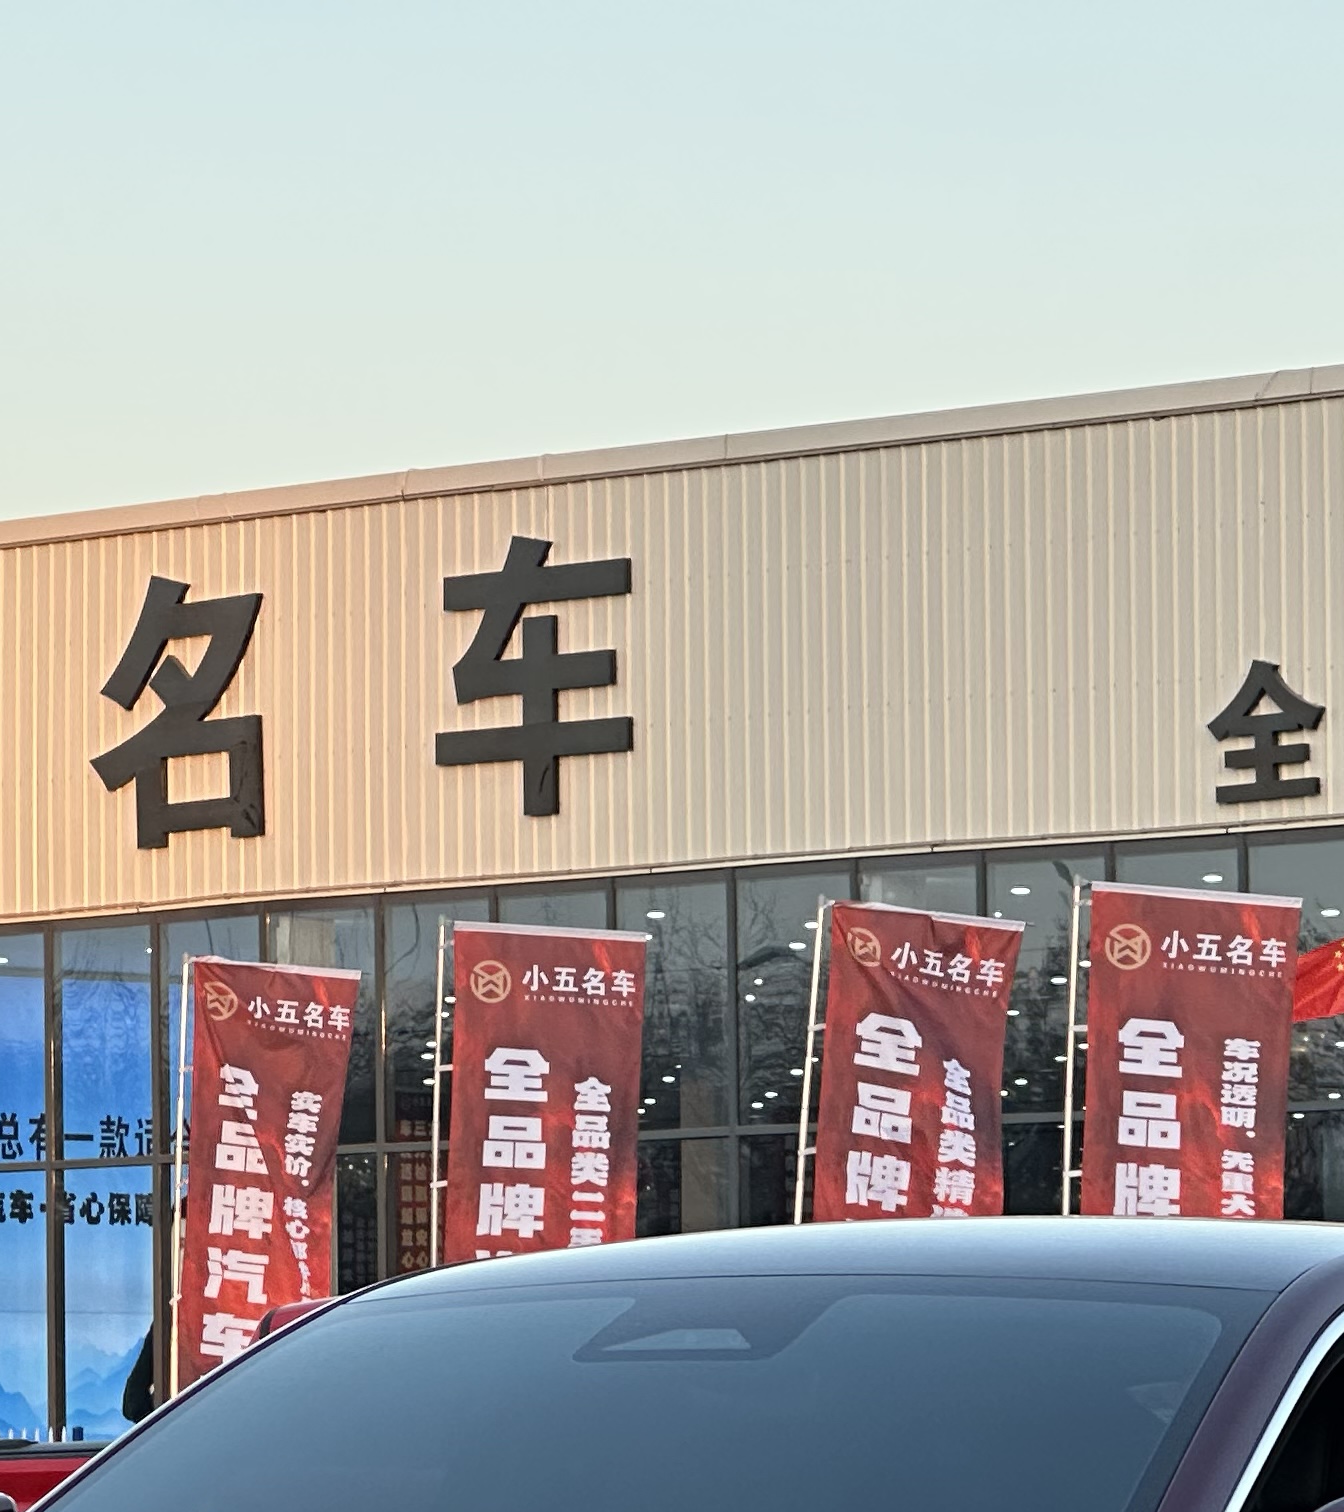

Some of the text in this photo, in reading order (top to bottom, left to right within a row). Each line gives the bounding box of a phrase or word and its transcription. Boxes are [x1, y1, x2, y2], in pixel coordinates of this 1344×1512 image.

[890, 942, 1006, 987] 小五名车
[1160, 930, 1287, 968] 小五名车
[522, 964, 636, 998] 小五名车
[248, 996, 351, 1031] 小五名车
[845, 1011, 923, 1213] 全品牌
[475, 1047, 550, 1260] 全品牌
